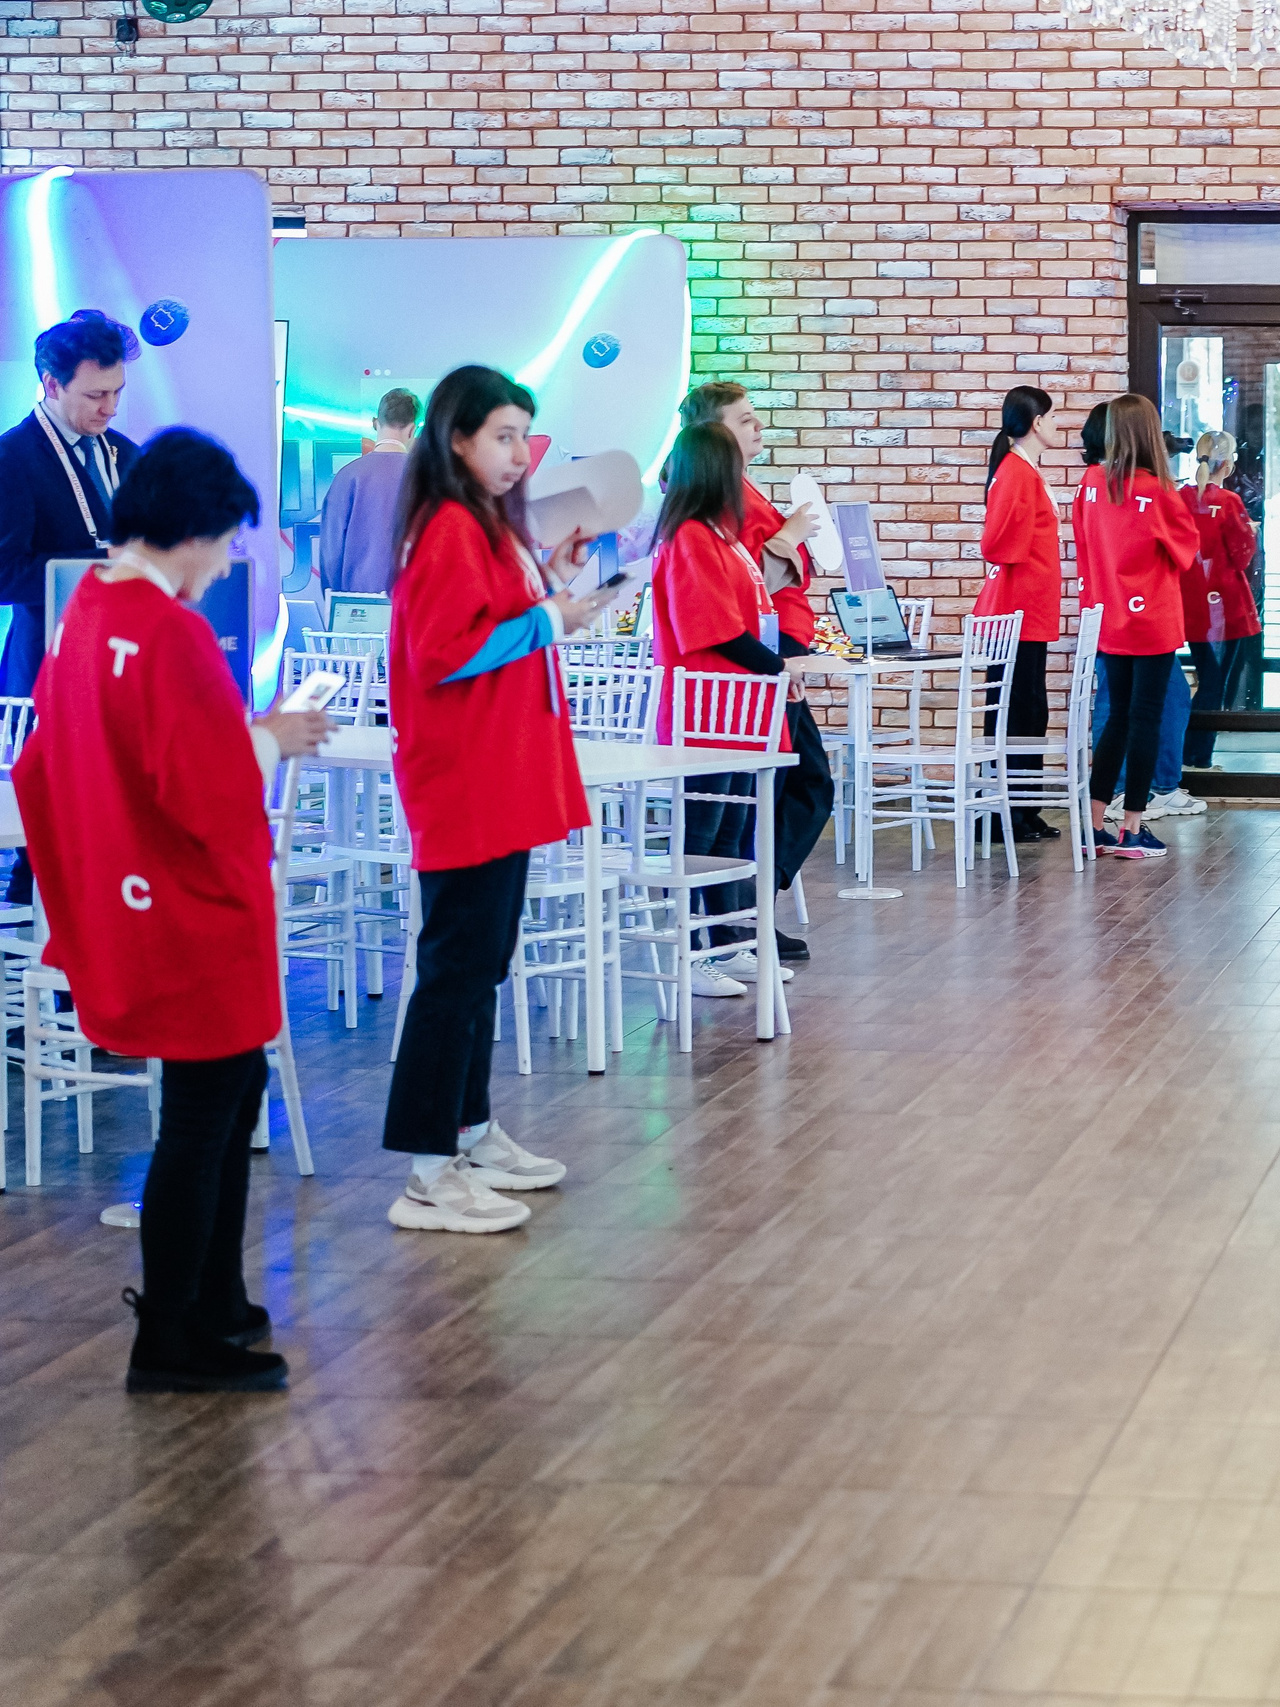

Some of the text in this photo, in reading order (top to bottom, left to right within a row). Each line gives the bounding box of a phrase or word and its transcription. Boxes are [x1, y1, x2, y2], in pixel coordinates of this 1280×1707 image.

[1135, 496, 1152, 512] Т
[1208, 505, 1221, 517] Т
[1129, 596, 1145, 612] С
[107, 636, 139, 678] Т
[121, 874, 152, 911] С
